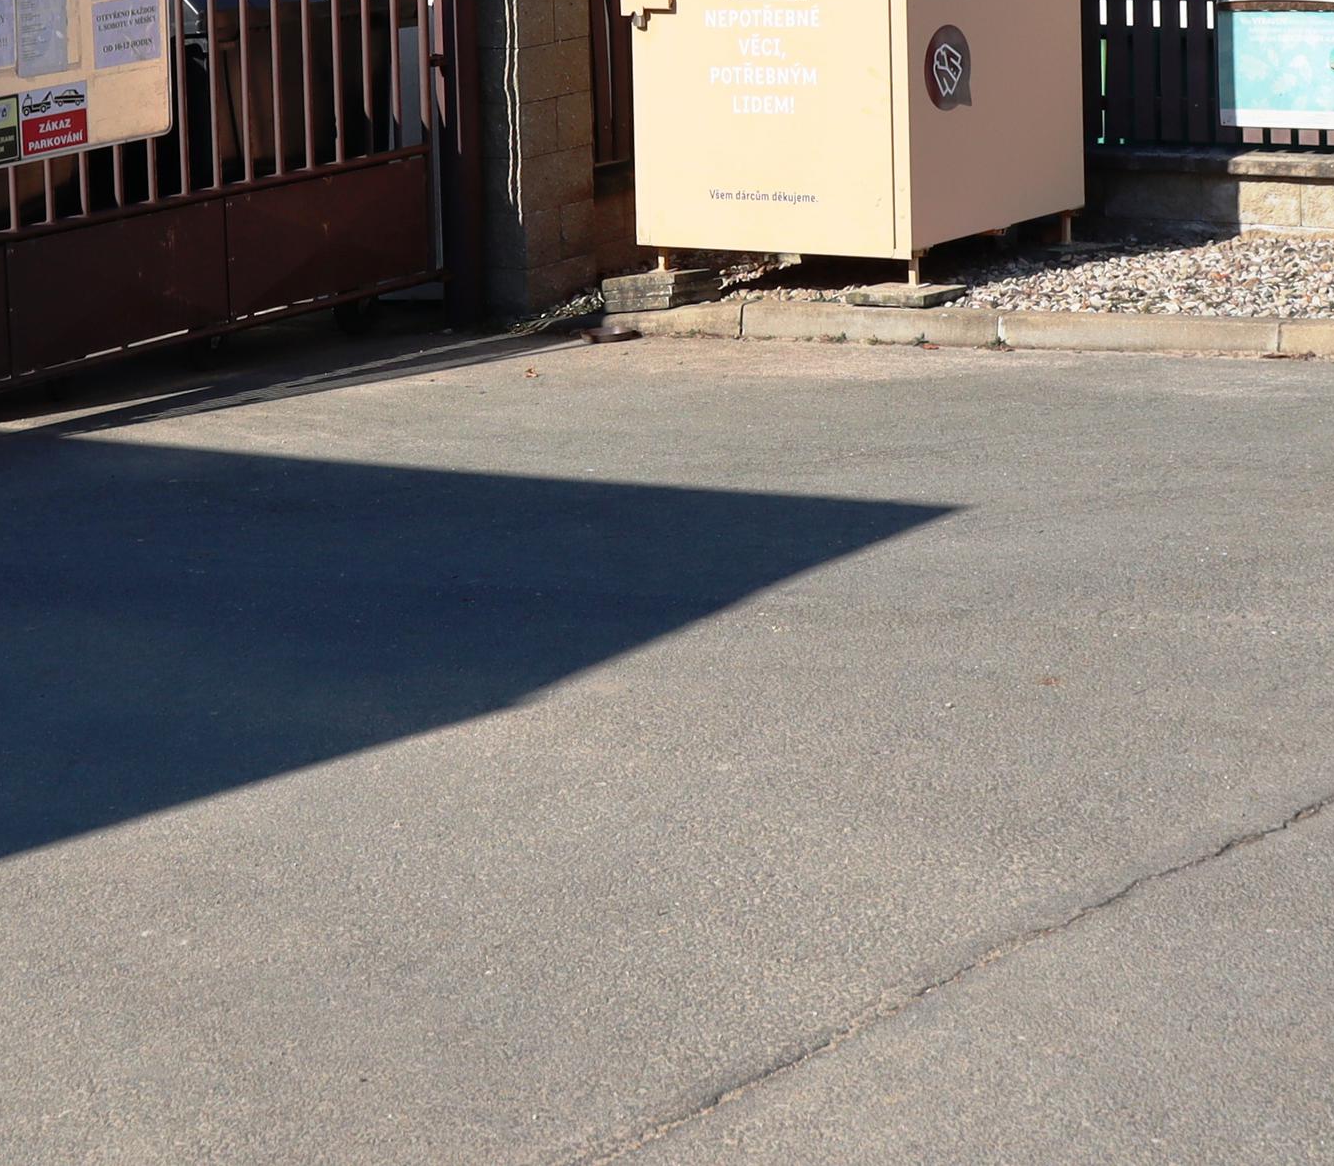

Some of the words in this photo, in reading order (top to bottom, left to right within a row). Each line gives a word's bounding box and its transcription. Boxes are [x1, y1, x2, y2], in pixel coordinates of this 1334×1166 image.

[704, 4, 820, 28] NEPOTŘEBNÉ
[738, 34, 786, 60] VĚCI,
[710, 61, 818, 85] POTŘEBNÝM
[732, 95, 796, 114] LIDEM!
[39, 118, 72, 133] ZÁKAZ
[28, 130, 84, 152] PARKOVÁNÍ
[709, 189, 733, 200] Všem
[735, 189, 769, 201] dárcům
[772, 191, 819, 205] děkujeme.
